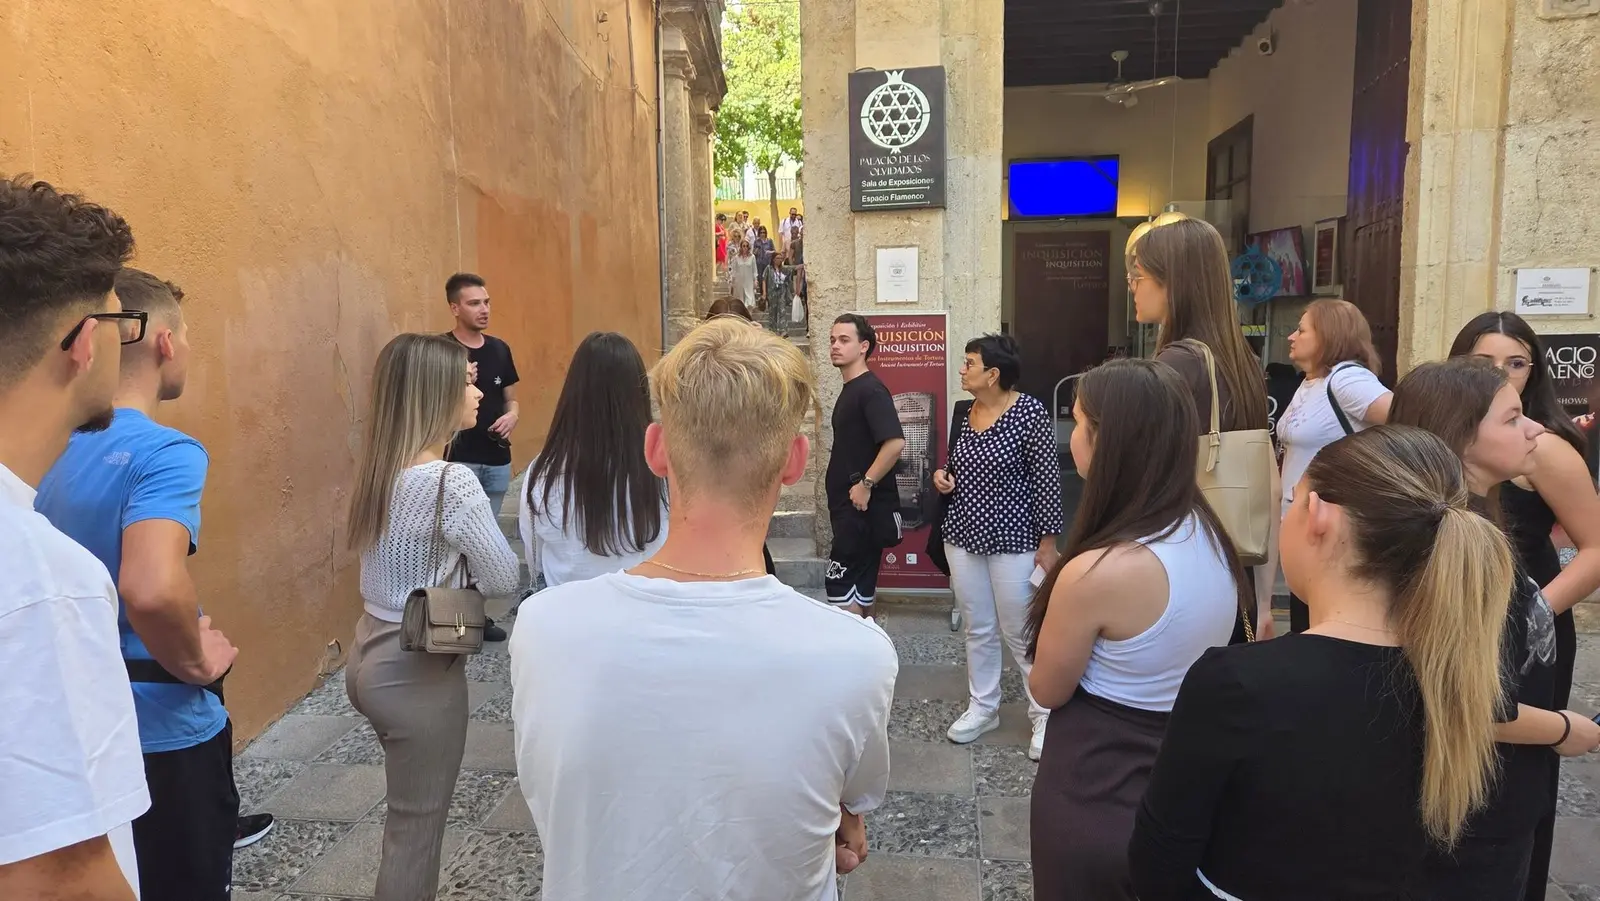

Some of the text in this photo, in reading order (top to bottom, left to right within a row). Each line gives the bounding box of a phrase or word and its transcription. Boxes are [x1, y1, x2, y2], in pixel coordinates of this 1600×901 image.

[860, 154, 930, 166] PALACIO DE LOS
[869, 166, 922, 176] OLVIDADOS
[878, 179, 888, 187] de
[888, 177, 935, 187] Exposiciones
[861, 193, 925, 203] Espacio Flamenco
[1045, 260, 1103, 269] INQUISITION
[879, 343, 945, 353] INQUISITION
[1545, 346, 1597, 364] ACIO
[1556, 397, 1588, 405] SHOWS
